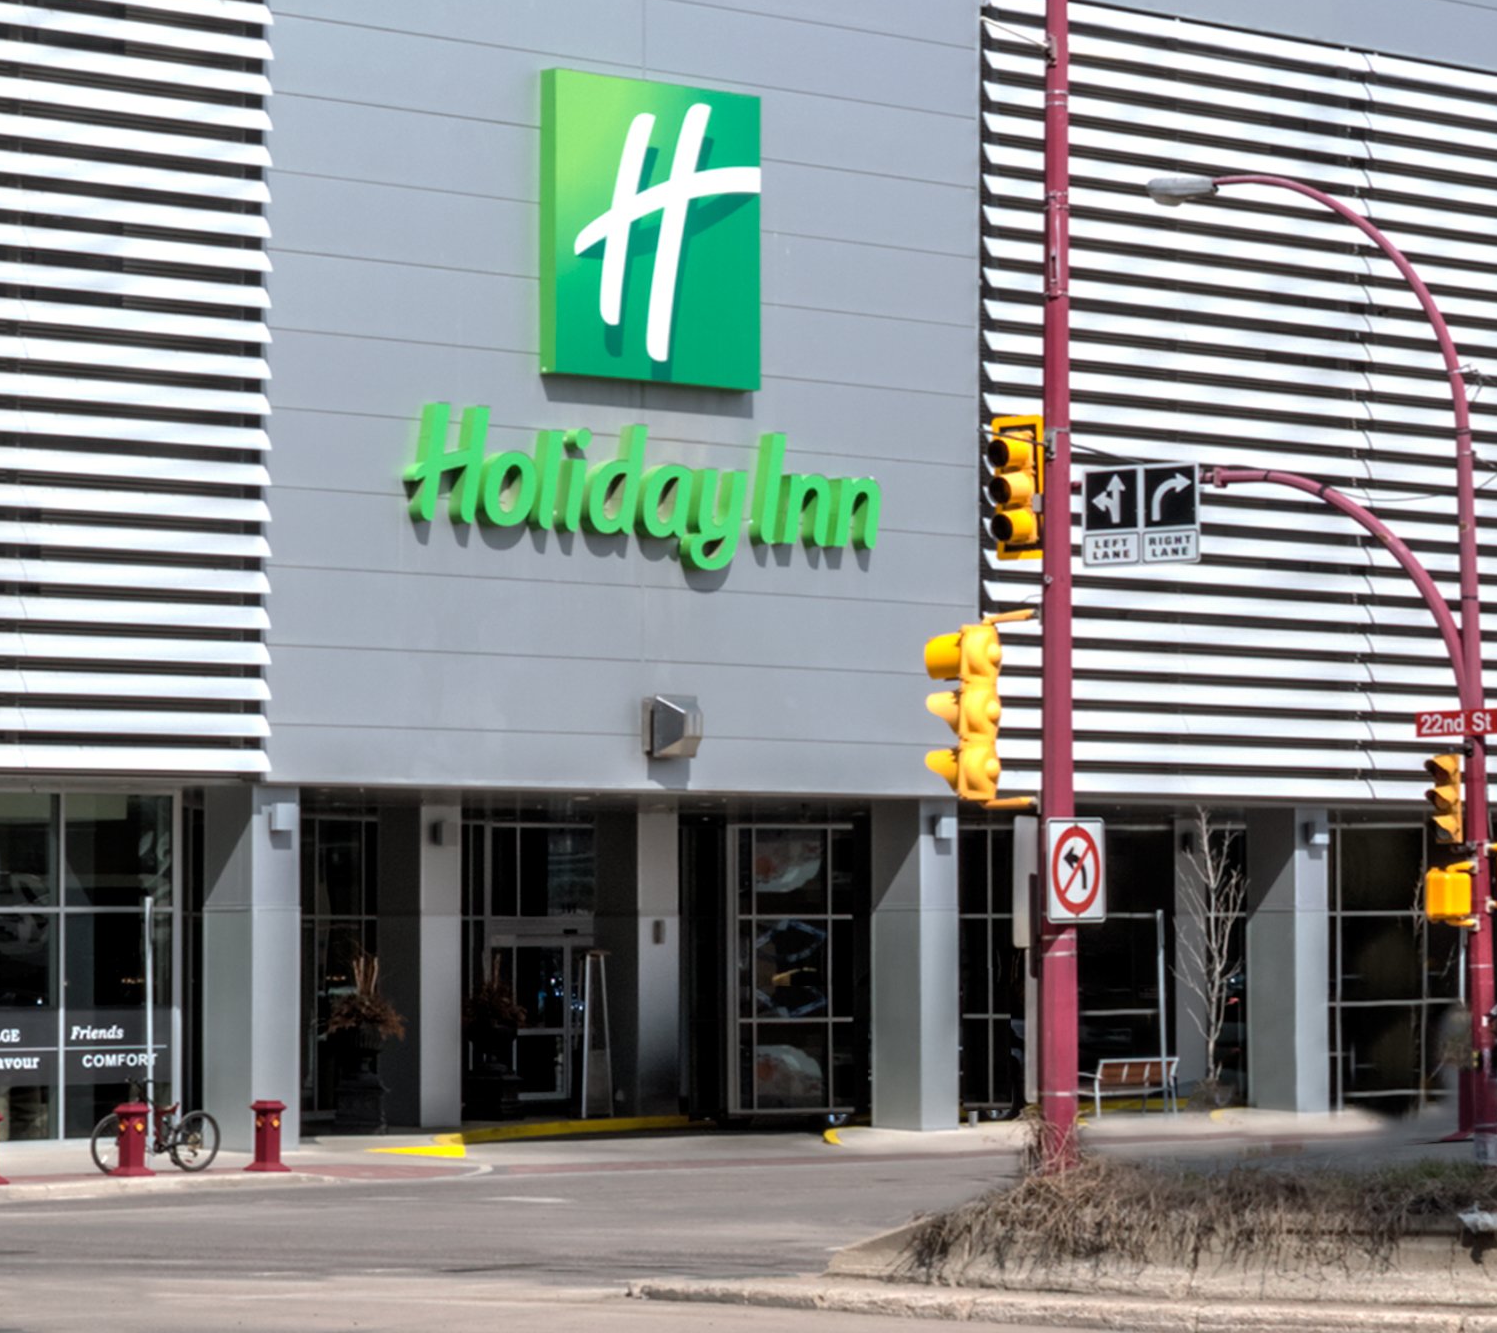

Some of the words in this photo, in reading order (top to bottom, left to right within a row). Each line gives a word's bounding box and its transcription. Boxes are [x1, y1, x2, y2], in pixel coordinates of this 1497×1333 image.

[402, 401, 747, 572] Holiday
[749, 431, 882, 551] Inn
[1094, 538, 1129, 549] LEFT
[1148, 535, 1192, 546] RIGHT
[1092, 549, 1131, 560] LANE
[1151, 546, 1189, 558] LANE
[1420, 713, 1464, 734] 22nd
[1472, 712, 1492, 732] St
[70, 1025, 124, 1040] Friends
[82, 1053, 158, 1068] COMFORT
